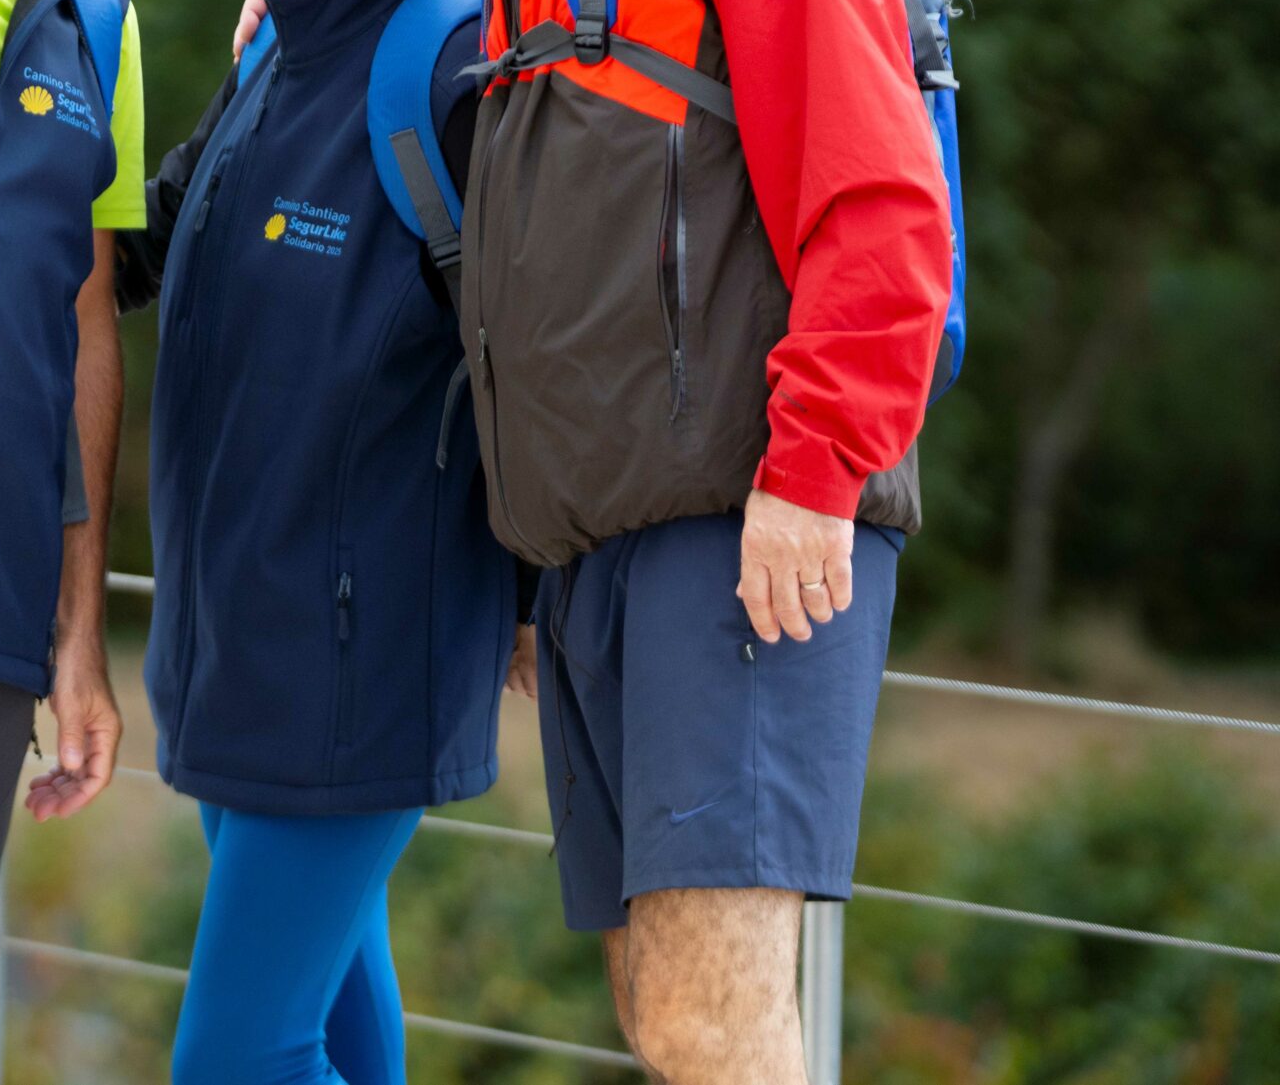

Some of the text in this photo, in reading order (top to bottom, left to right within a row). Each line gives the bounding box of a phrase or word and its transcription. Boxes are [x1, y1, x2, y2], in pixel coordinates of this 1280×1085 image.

[23, 66, 64, 90] Camino
[56, 109, 90, 131] Solidario
[273, 196, 351, 226] Camino Santiago
[288, 215, 347, 241] SegurLike
[283, 233, 325, 253] Solidario
